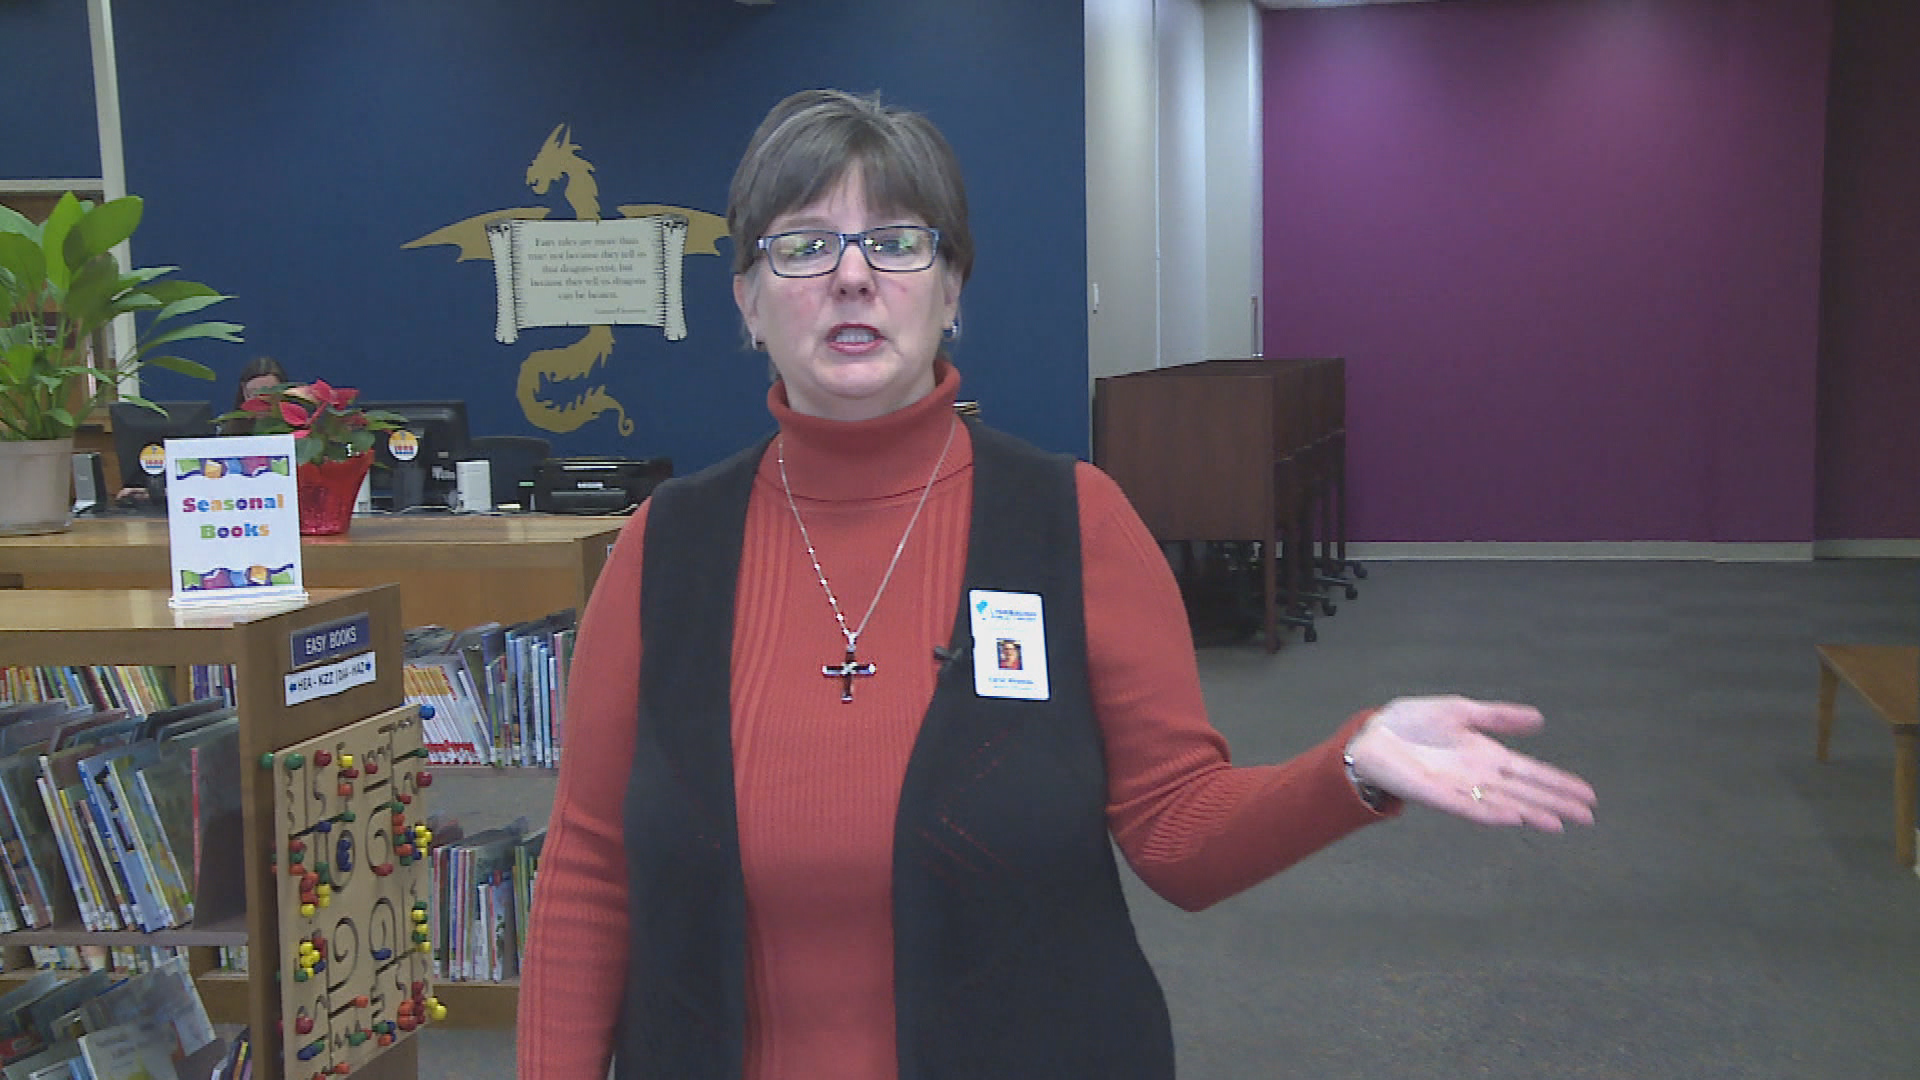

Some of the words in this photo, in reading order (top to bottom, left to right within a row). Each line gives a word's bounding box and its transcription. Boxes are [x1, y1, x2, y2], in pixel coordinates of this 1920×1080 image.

[182, 493, 285, 513] Seasonal
[200, 522, 270, 539] Books
[305, 633, 327, 655] EASY
[329, 625, 357, 649] BOOKS
